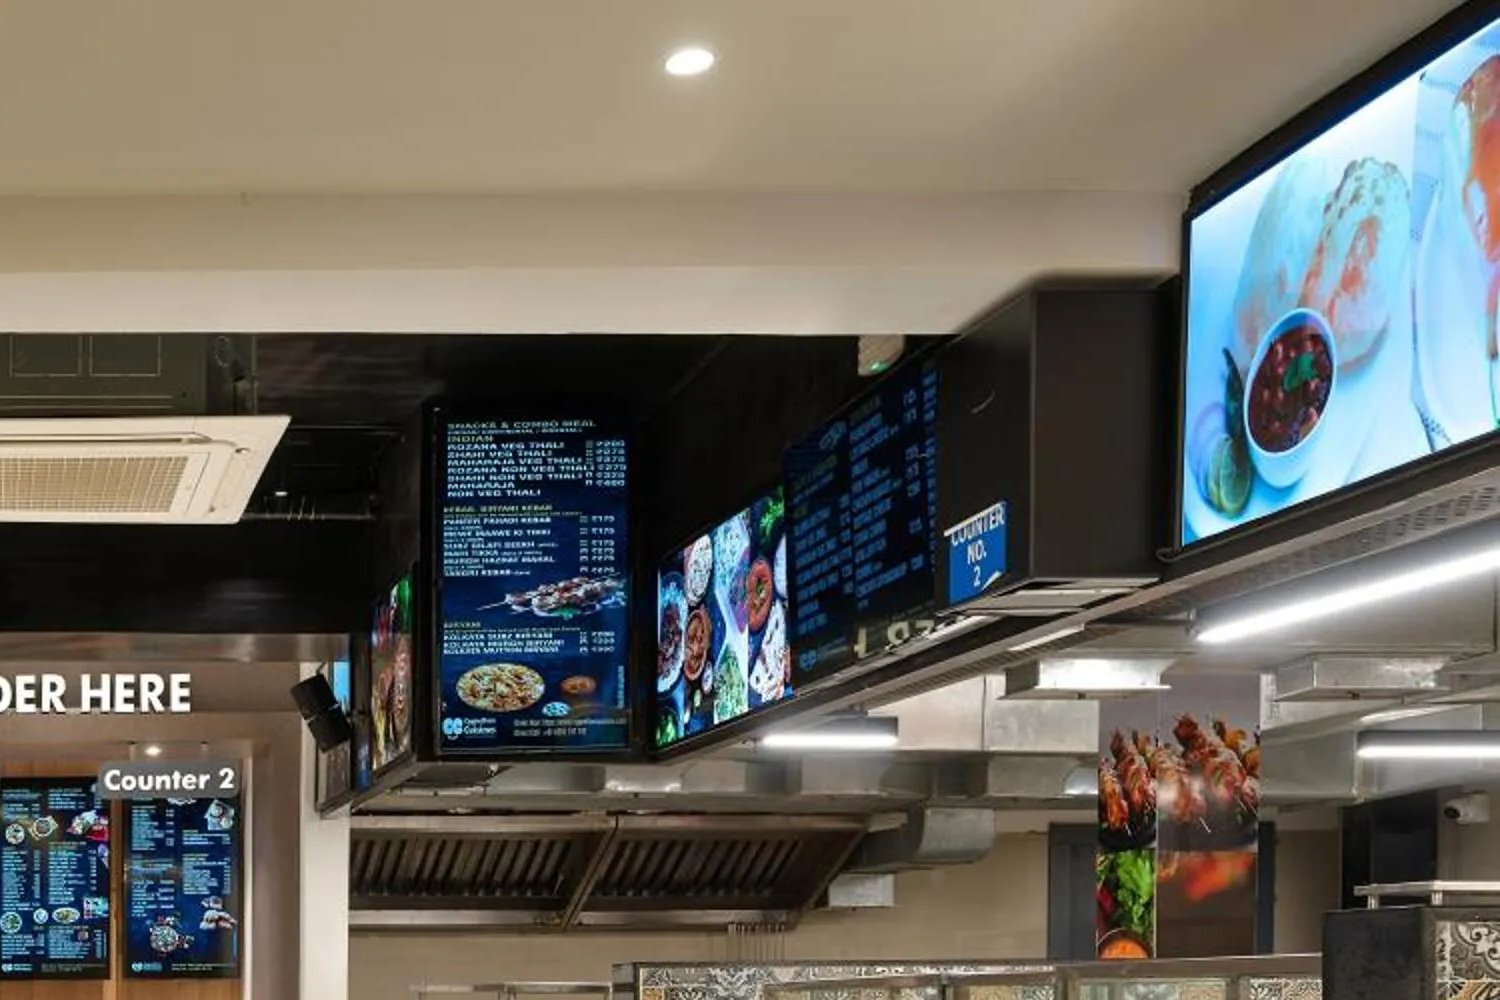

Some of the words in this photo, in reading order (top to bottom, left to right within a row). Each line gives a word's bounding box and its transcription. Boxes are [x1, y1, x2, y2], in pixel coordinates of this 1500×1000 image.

[447, 435, 494, 443] INDIAN
[501, 441, 525, 449] VEG
[529, 441, 565, 449] THALI
[517, 449, 553, 457] THALI
[519, 457, 543, 465] VEG
[501, 465, 528, 473] NON
[531, 464, 555, 472] VEG
[519, 473, 543, 481] VEG
[447, 490, 475, 498] NON
[477, 489, 502, 497] VEG
[506, 488, 541, 497] THALI
[951, 502, 1005, 548] COUNTER
[967, 539, 987, 565] NO.
[973, 565, 981, 587] 2
[80, 673, 191, 713] HERE
[103, 769, 211, 791] Counter
[218, 768, 235, 789] 2
